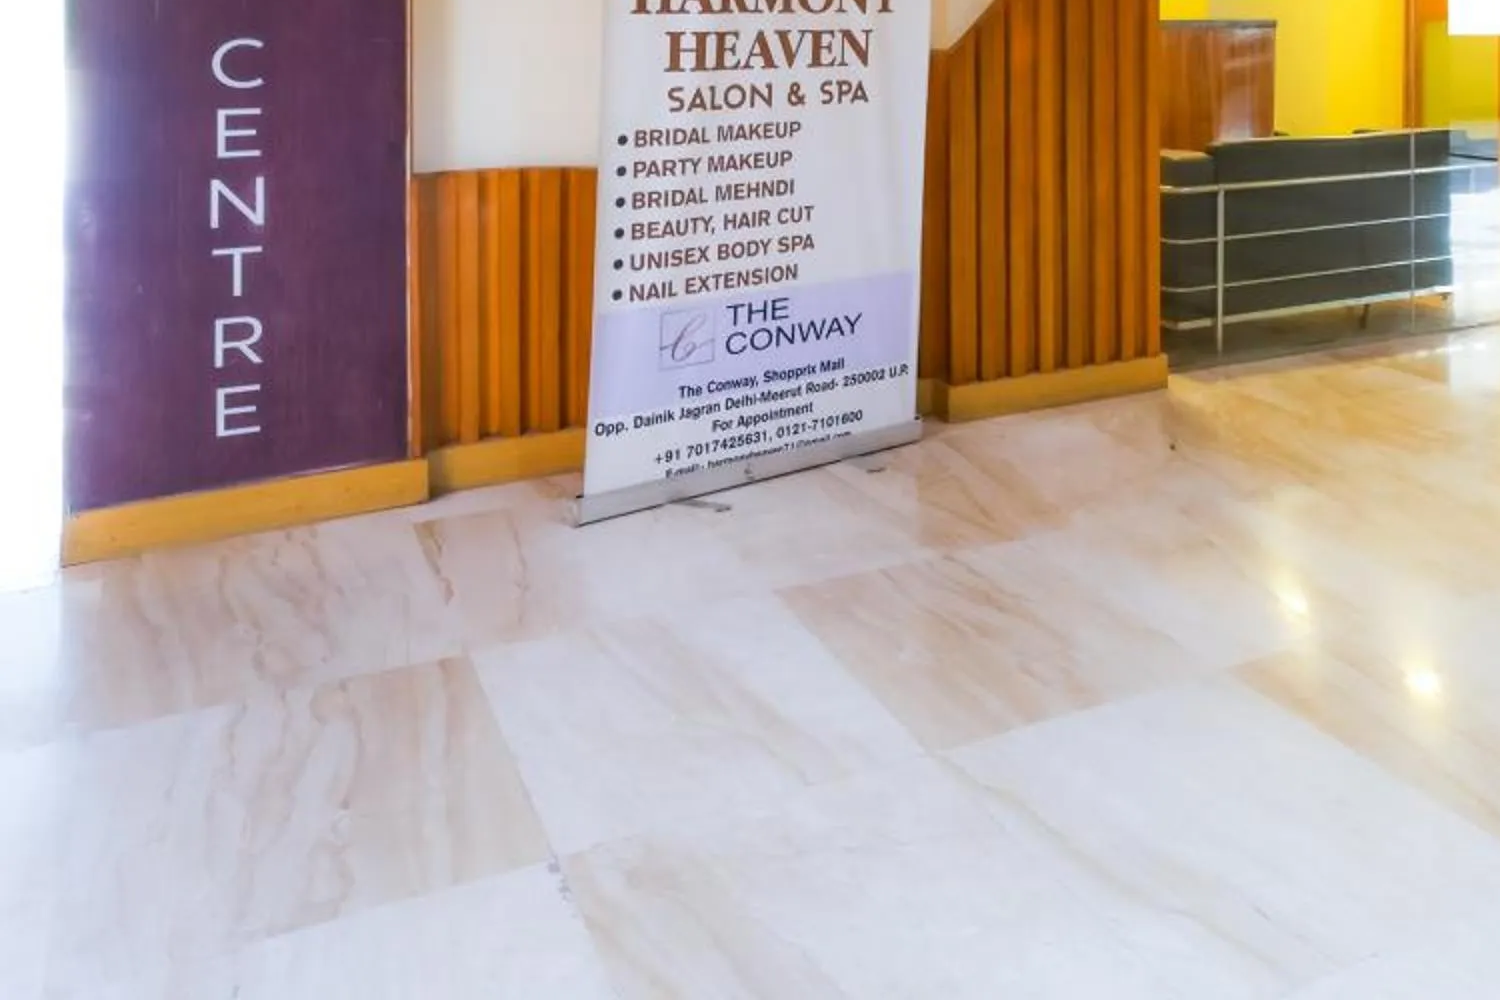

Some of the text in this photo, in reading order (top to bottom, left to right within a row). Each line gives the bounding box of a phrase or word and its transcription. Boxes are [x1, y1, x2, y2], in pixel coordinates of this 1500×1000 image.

[663, 28, 873, 72] HEAVEN
[667, 80, 869, 113] SALON & SPA
[634, 120, 802, 149] BRIDAL MAKEUP
[632, 150, 793, 179] PARTY MAKEUP
[631, 179, 795, 211] BRIDAL MEHNDI
[208, 36, 267, 438] CENTRE
[630, 205, 815, 241] BEAUTY, HAIR CUT
[629, 234, 815, 271] UNISEX BODY SPA
[628, 263, 799, 303] NAIL EXTENSION
[726, 297, 791, 327] THE
[725, 313, 863, 356] CONWAY
[679, 357, 845, 399] The Conway, Shopprix Mall
[595, 420, 629, 438] Opp.
[633, 409, 675, 430] Dainik
[679, 402, 721, 421] Jagran
[725, 384, 802, 411] Delhi-Meerut
[843, 367, 886, 388] 250002
[711, 401, 814, 432] For Appointment
[655, 449, 680, 464] +91
